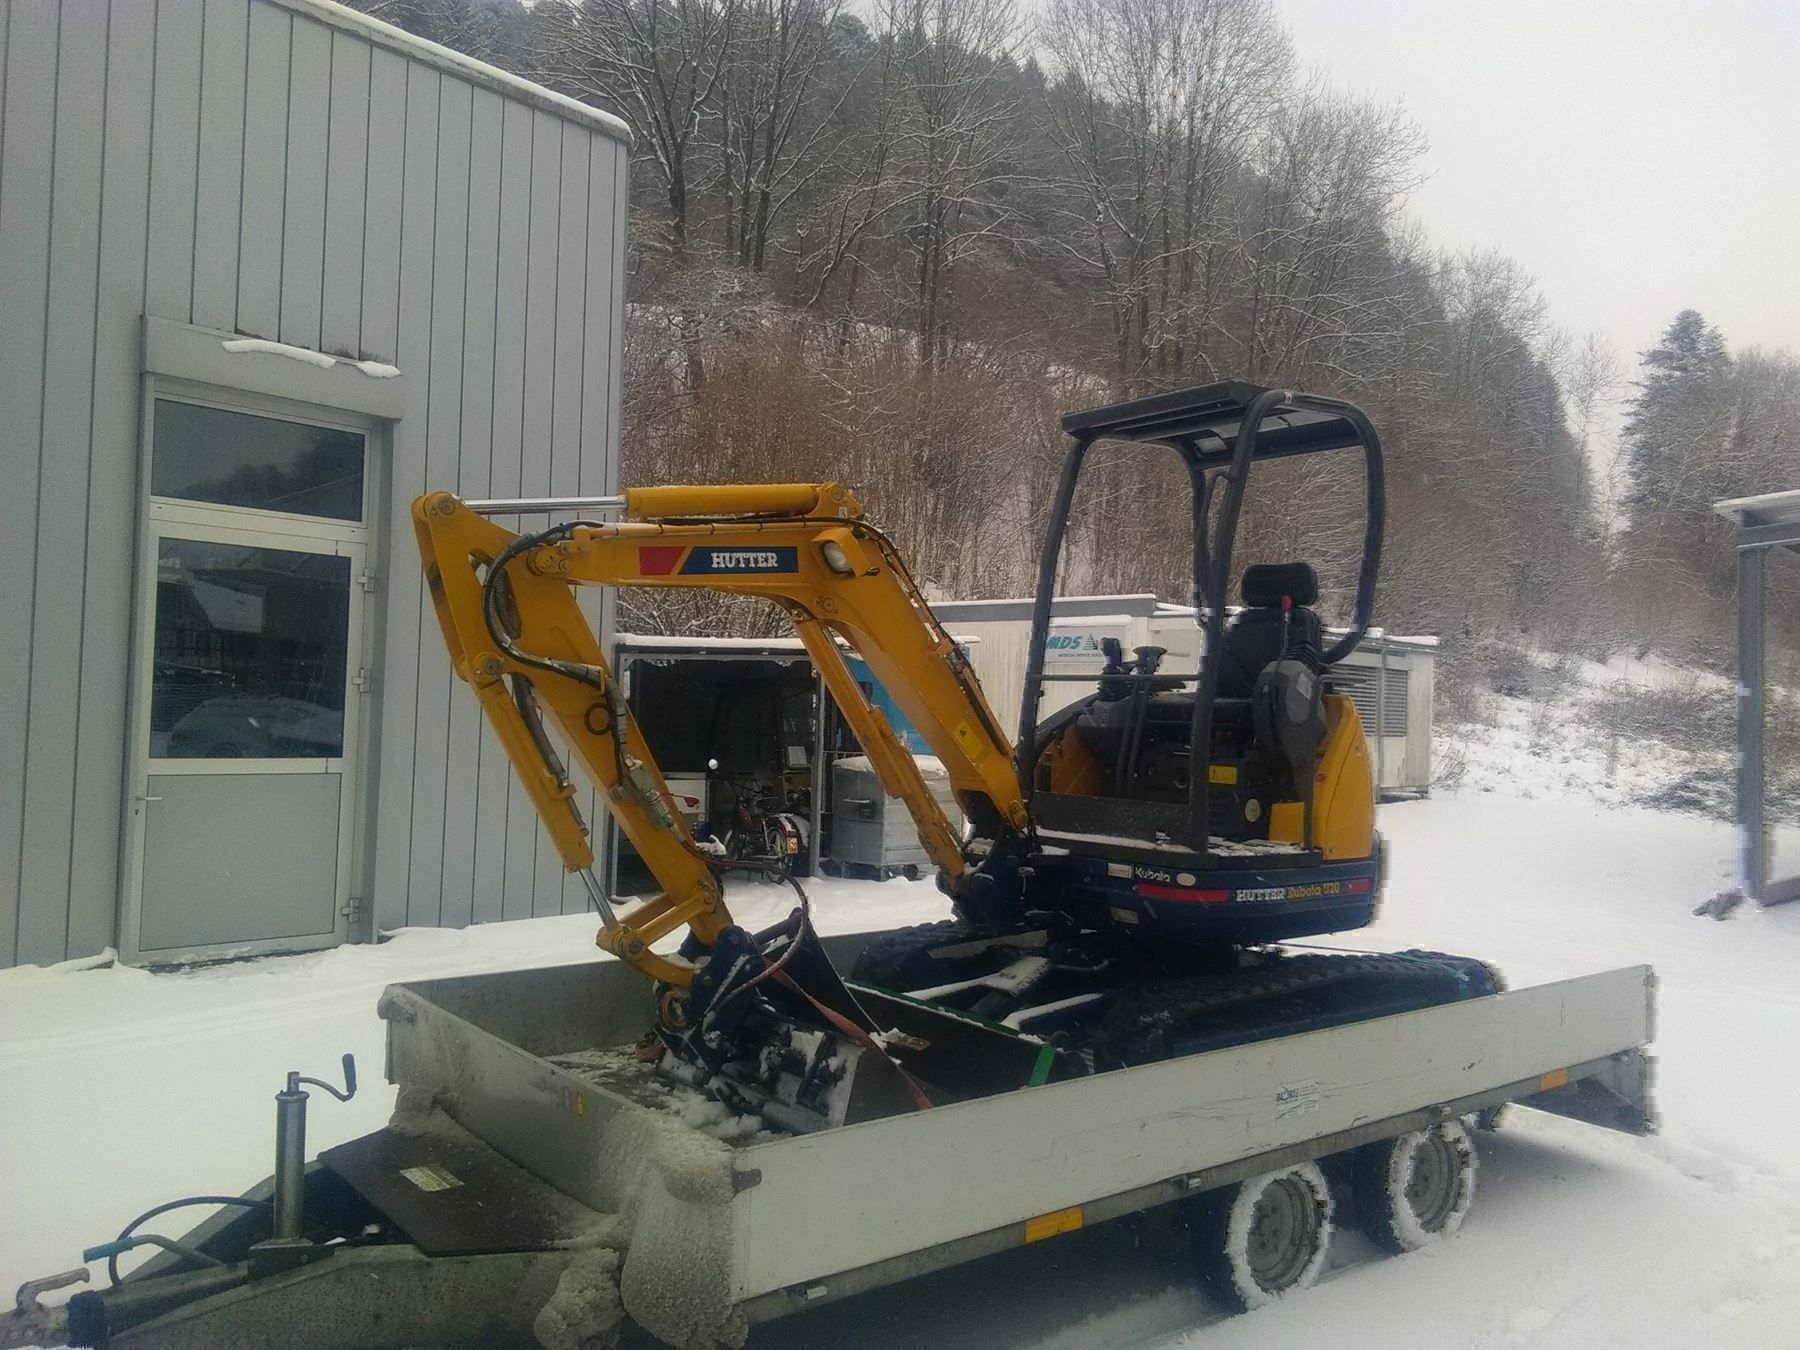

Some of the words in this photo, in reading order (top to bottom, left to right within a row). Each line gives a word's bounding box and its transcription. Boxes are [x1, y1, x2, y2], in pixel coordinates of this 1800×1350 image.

[711, 552, 778, 568] HUTTER
[1135, 866, 1170, 882] Kubota
[1235, 887, 1285, 901] HUTTER
[1286, 884, 1321, 898] Kubota
[1322, 881, 1340, 894] U20
